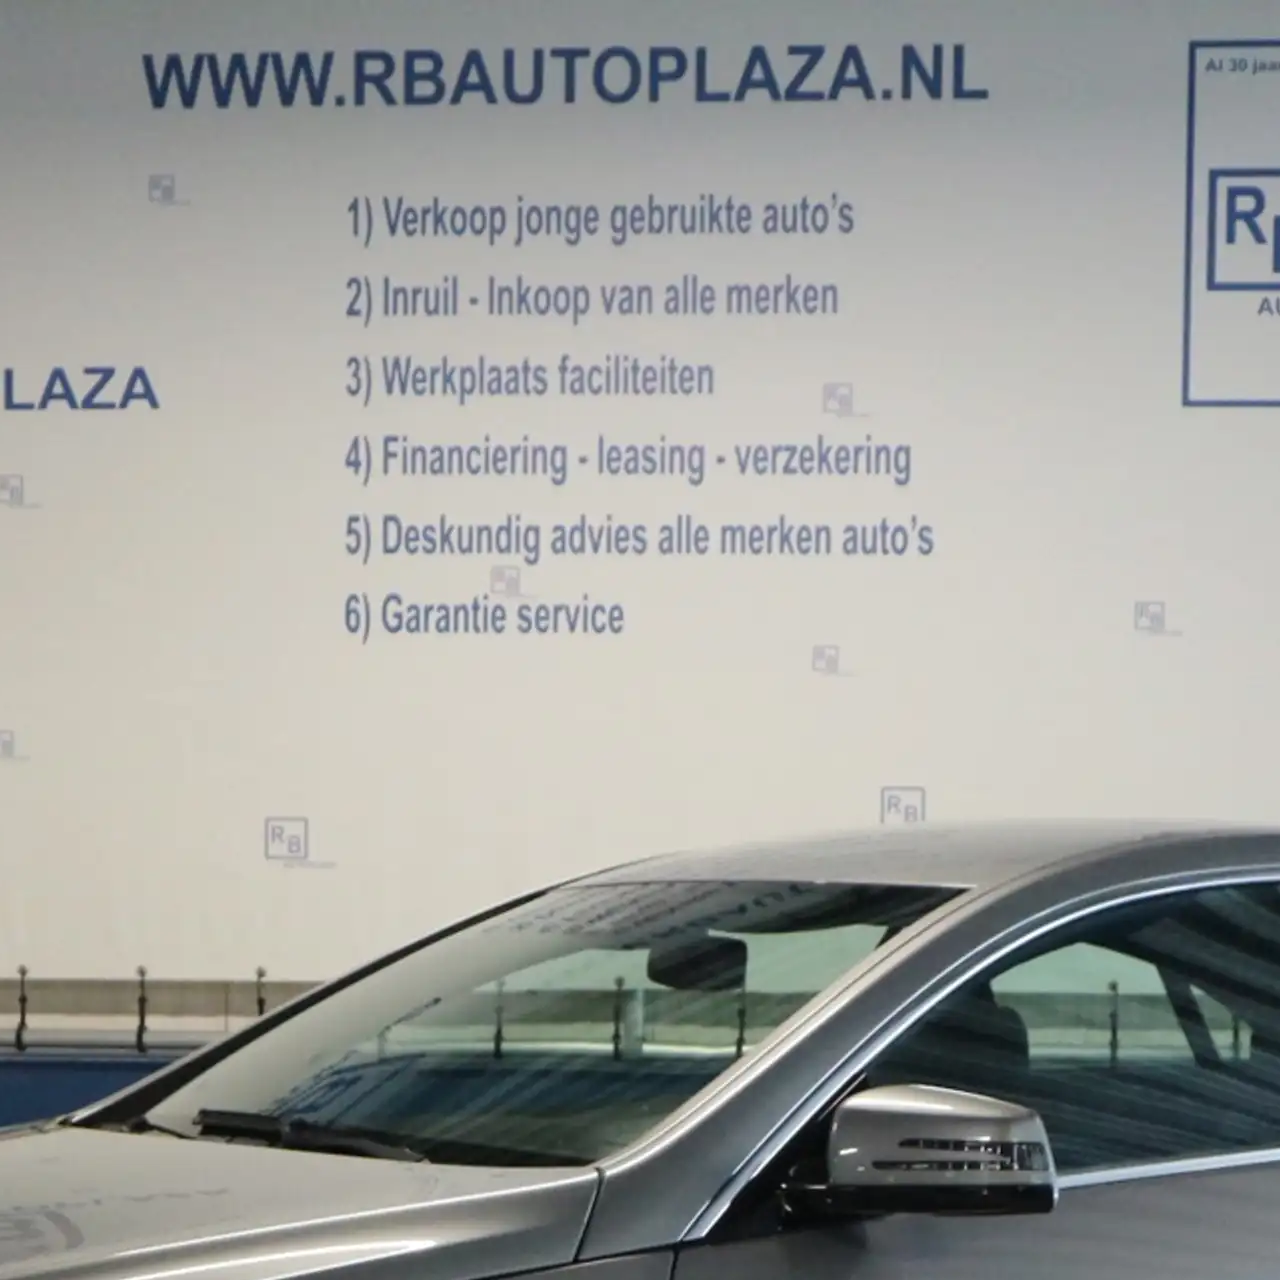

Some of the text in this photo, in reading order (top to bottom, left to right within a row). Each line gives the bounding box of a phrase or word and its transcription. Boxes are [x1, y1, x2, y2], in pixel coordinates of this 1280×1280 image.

[142, 44, 990, 109] WWW.RBAUTOPLAZA.NL
[348, 193, 854, 247] 1) Verkoop jonge gebruikte auto's
[346, 276, 372, 327] 2)
[383, 276, 459, 317] Inruil
[489, 276, 591, 326] Inkoop
[601, 285, 653, 316] van
[665, 275, 716, 316] alle
[727, 274, 838, 315] merken
[346, 355, 714, 407] 3) Werkplaats faciliteiten
[345, 436, 372, 486] 4)
[382, 435, 568, 486] Financiering
[597, 435, 705, 486] leasing
[734, 434, 912, 486] verzekering
[346, 514, 935, 566] 5) Deskundig advies alle merken auto's
[345, 592, 625, 645] 6) Garantie service
